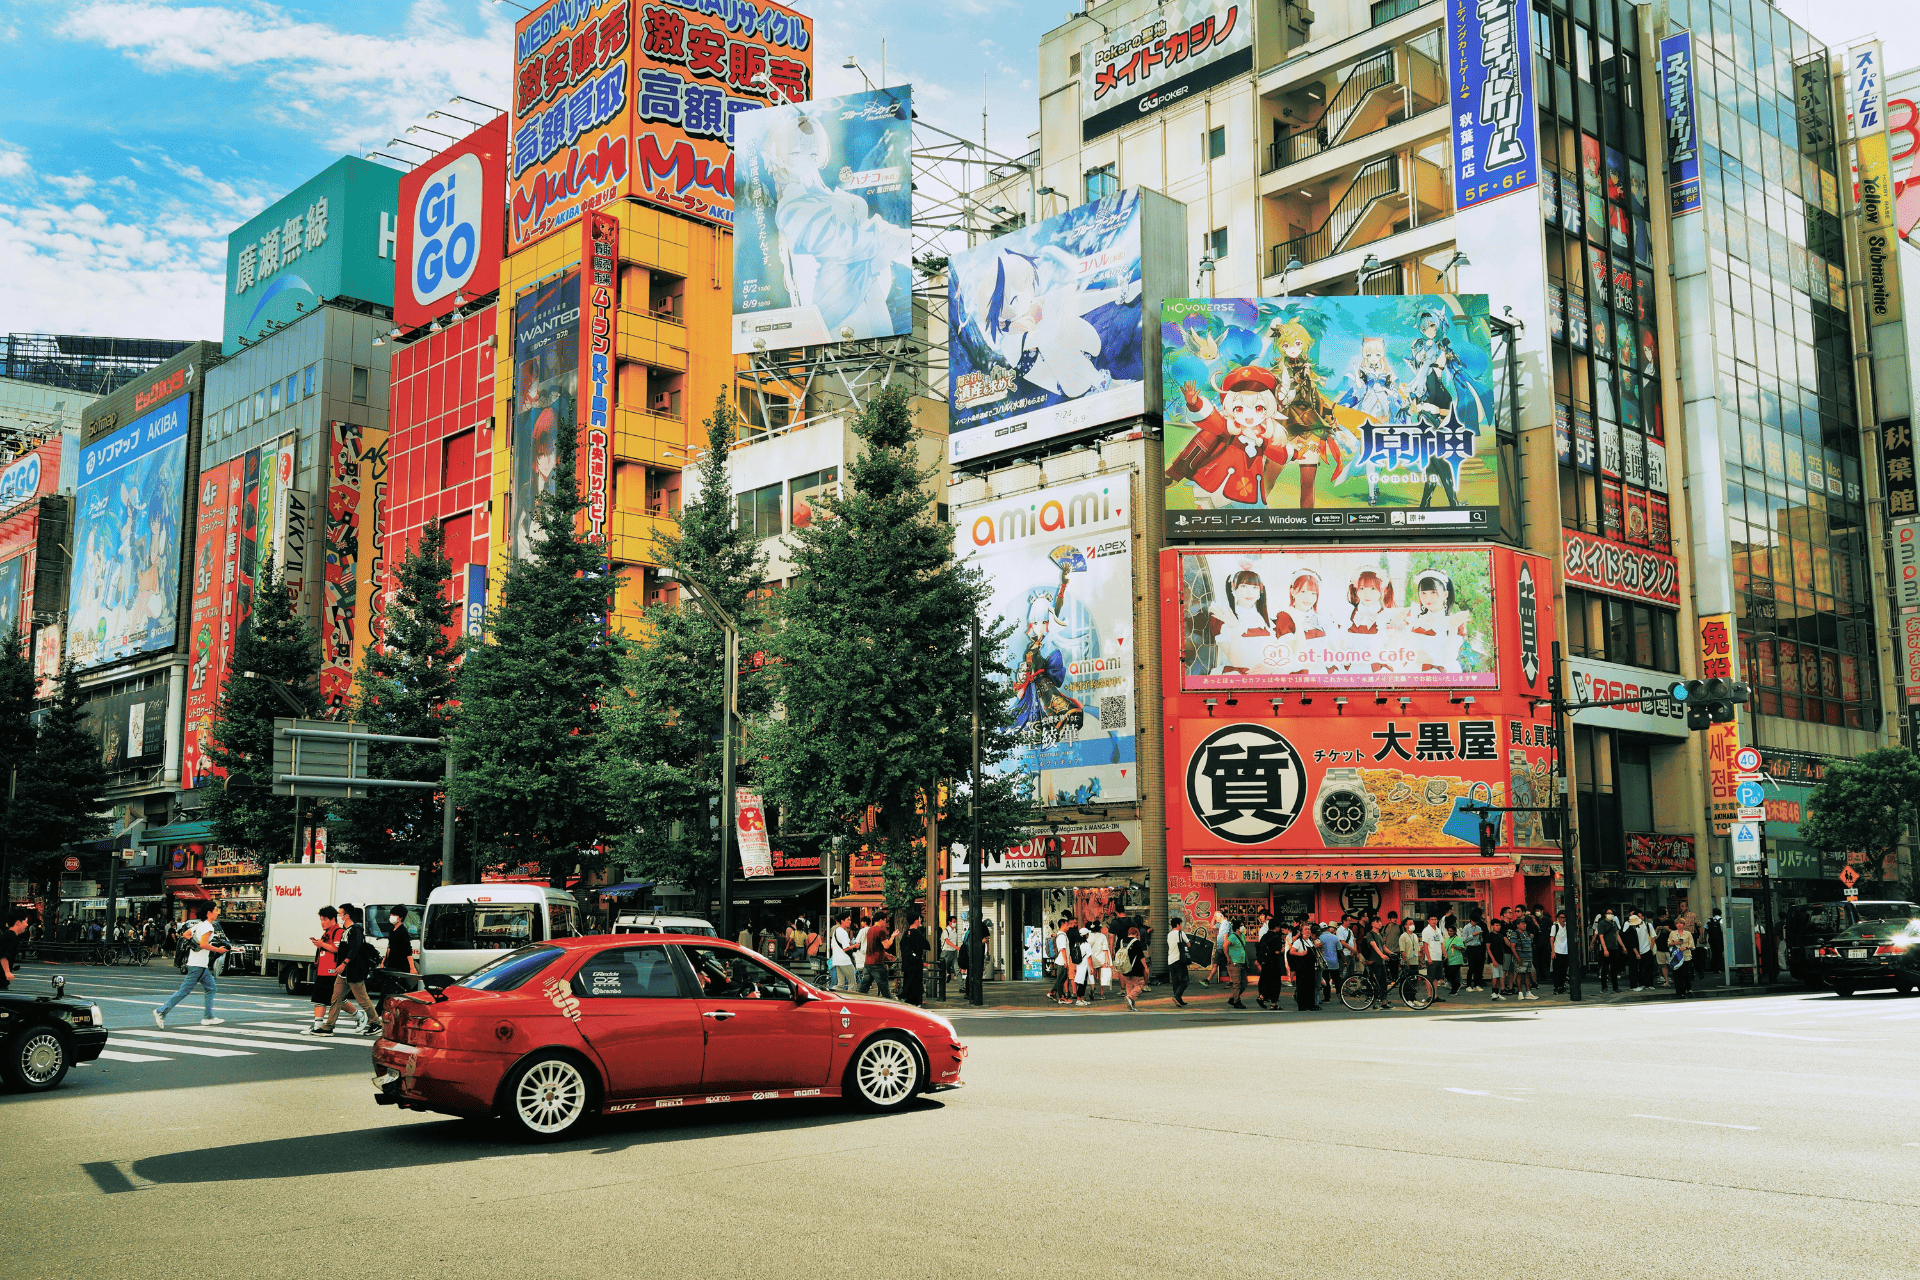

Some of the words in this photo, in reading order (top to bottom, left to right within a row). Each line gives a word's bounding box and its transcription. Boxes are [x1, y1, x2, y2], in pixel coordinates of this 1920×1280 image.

[644, 7, 805, 104] 激安販売
[1093, 5, 1239, 102] メイドカジノ
[1094, 19, 1168, 67] Pokerの聖地
[517, 3, 627, 115] 激安販売
[1138, 85, 1190, 113] GGPOKER
[1856, 51, 1879, 130] スーパービル
[512, 63, 624, 180] 高額買取
[1459, 111, 1476, 180] 秋葉原店
[511, 134, 628, 241] Mulan
[850, 173, 881, 185] ハナコ
[656, 186, 708, 213] ムーラン
[1861, 176, 1882, 225] Yellow
[523, 218, 555, 244] ムーラン
[554, 205, 581, 226] AKIBA
[1563, 204, 1581, 232] 7F
[235, 196, 329, 295] 廣瀬無線
[594, 243, 613, 257] 買取
[1078, 253, 1110, 274] コハル
[1868, 235, 1888, 316] Submarine
[742, 284, 758, 295] 8/2
[742, 299, 758, 309] 8/9
[1166, 302, 1236, 314] HOYOVERSE
[519, 306, 580, 344] WANTED
[591, 286, 610, 354] ムーラン
[1570, 318, 1588, 349] 6F
[135, 368, 185, 413] ビックカメラ
[590, 353, 609, 429] AKIBA
[97, 427, 141, 467] ソフマップ
[146, 410, 178, 442] AKIBA
[1356, 402, 1476, 493] 原神
[1576, 438, 1595, 466] 5F
[1369, 472, 1438, 484] Genshin
[1825, 460, 1842, 478] Mac
[1884, 424, 1917, 514] 秋葉館
[201, 479, 218, 507] 4F
[1847, 482, 1860, 501] 5F
[287, 493, 307, 560] AKKY
[971, 487, 1110, 547] amiami
[1269, 514, 1307, 525] Windows
[224, 504, 239, 584] 秋葉原
[1097, 540, 1127, 553] APEX
[1567, 538, 1676, 597] メイドカジノ
[1899, 528, 1920, 603] amiami
[196, 566, 212, 594] 3F
[220, 590, 233, 674] Hey
[1068, 657, 1121, 675] amiami
[1269, 649, 1283, 658] at
[1297, 648, 1372, 663] at-home
[1378, 647, 1416, 662] cafe
[191, 662, 207, 690] 2F
[1312, 748, 1366, 764] チケット
[1371, 720, 1499, 763] 大黒屋
[1709, 722, 1727, 798] 세점
[1740, 753, 1756, 766] 40
[1201, 740, 1300, 830] 質
[1741, 788, 1753, 805] P
[1058, 825, 1084, 833] Magazine
[1006, 836, 1067, 858] COMC
[1070, 835, 1097, 856] ZIN
[1778, 850, 1818, 868] リバティー
[1004, 859, 1046, 869] Akihaba
[275, 885, 303, 897] Yakult
[593, 976, 620, 984] OZ
[610, 1103, 637, 1112] BLITZ
[655, 1098, 684, 1108] PIRELLI
[705, 1095, 731, 1104] sparco
